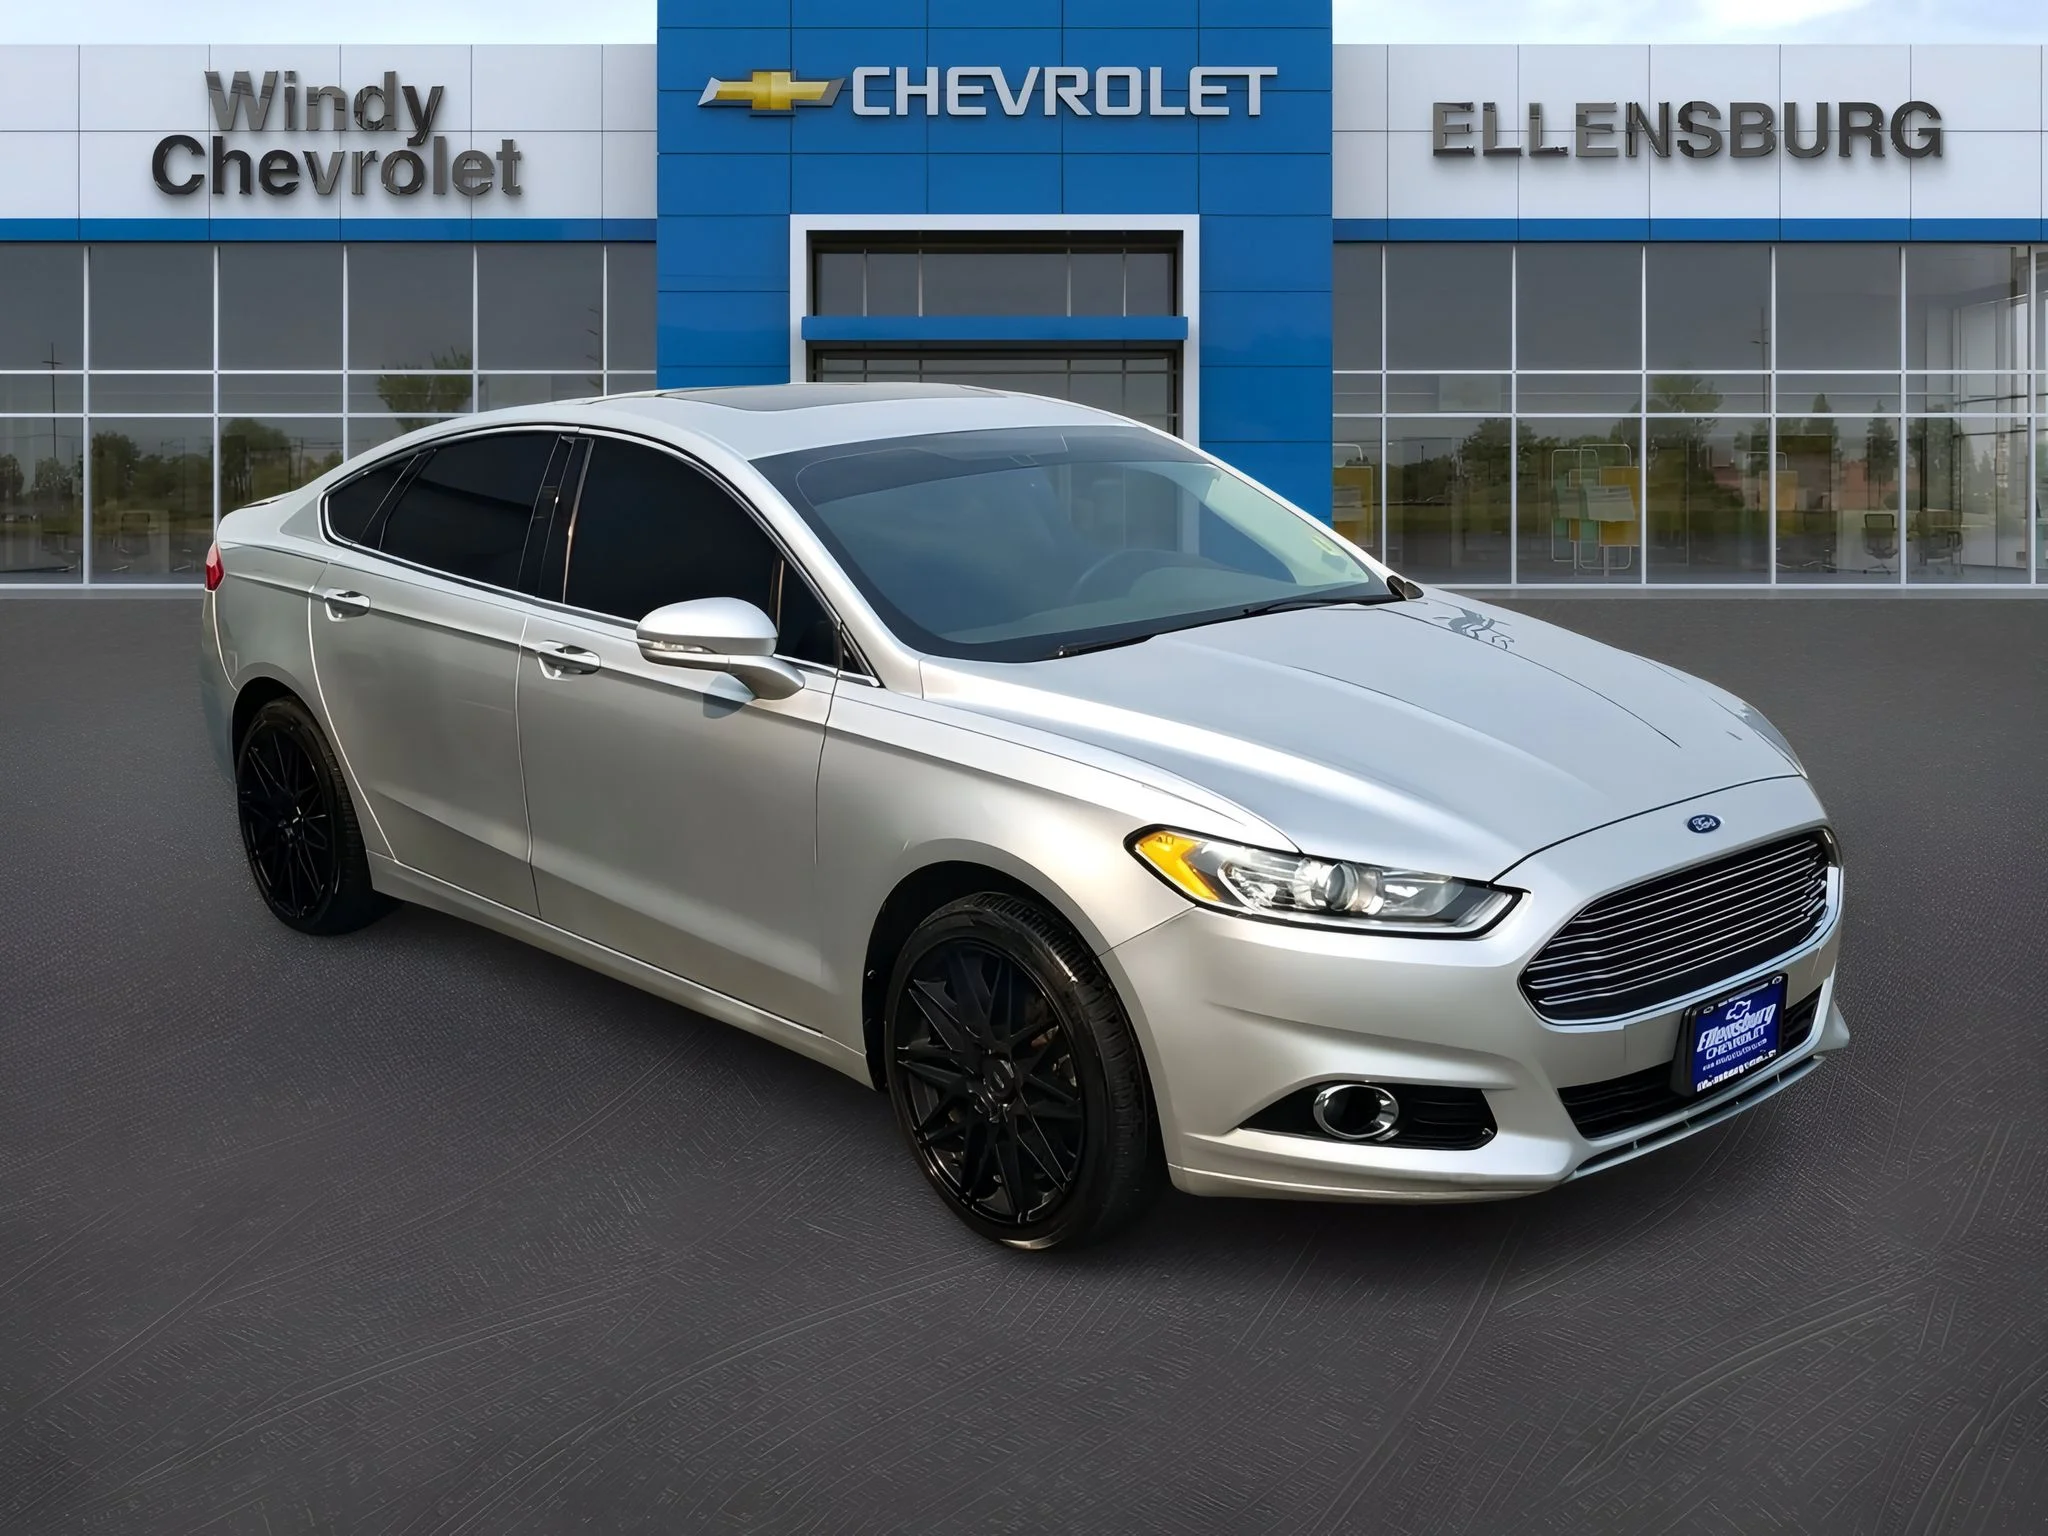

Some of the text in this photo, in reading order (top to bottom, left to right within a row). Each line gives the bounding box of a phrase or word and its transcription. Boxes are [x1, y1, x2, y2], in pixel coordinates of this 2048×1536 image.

[204, 70, 444, 146] Windy
[852, 66, 1278, 116] CHEVROLET
[1433, 101, 1943, 158] ELLENSBURG
[152, 134, 522, 196] Chevrolet
